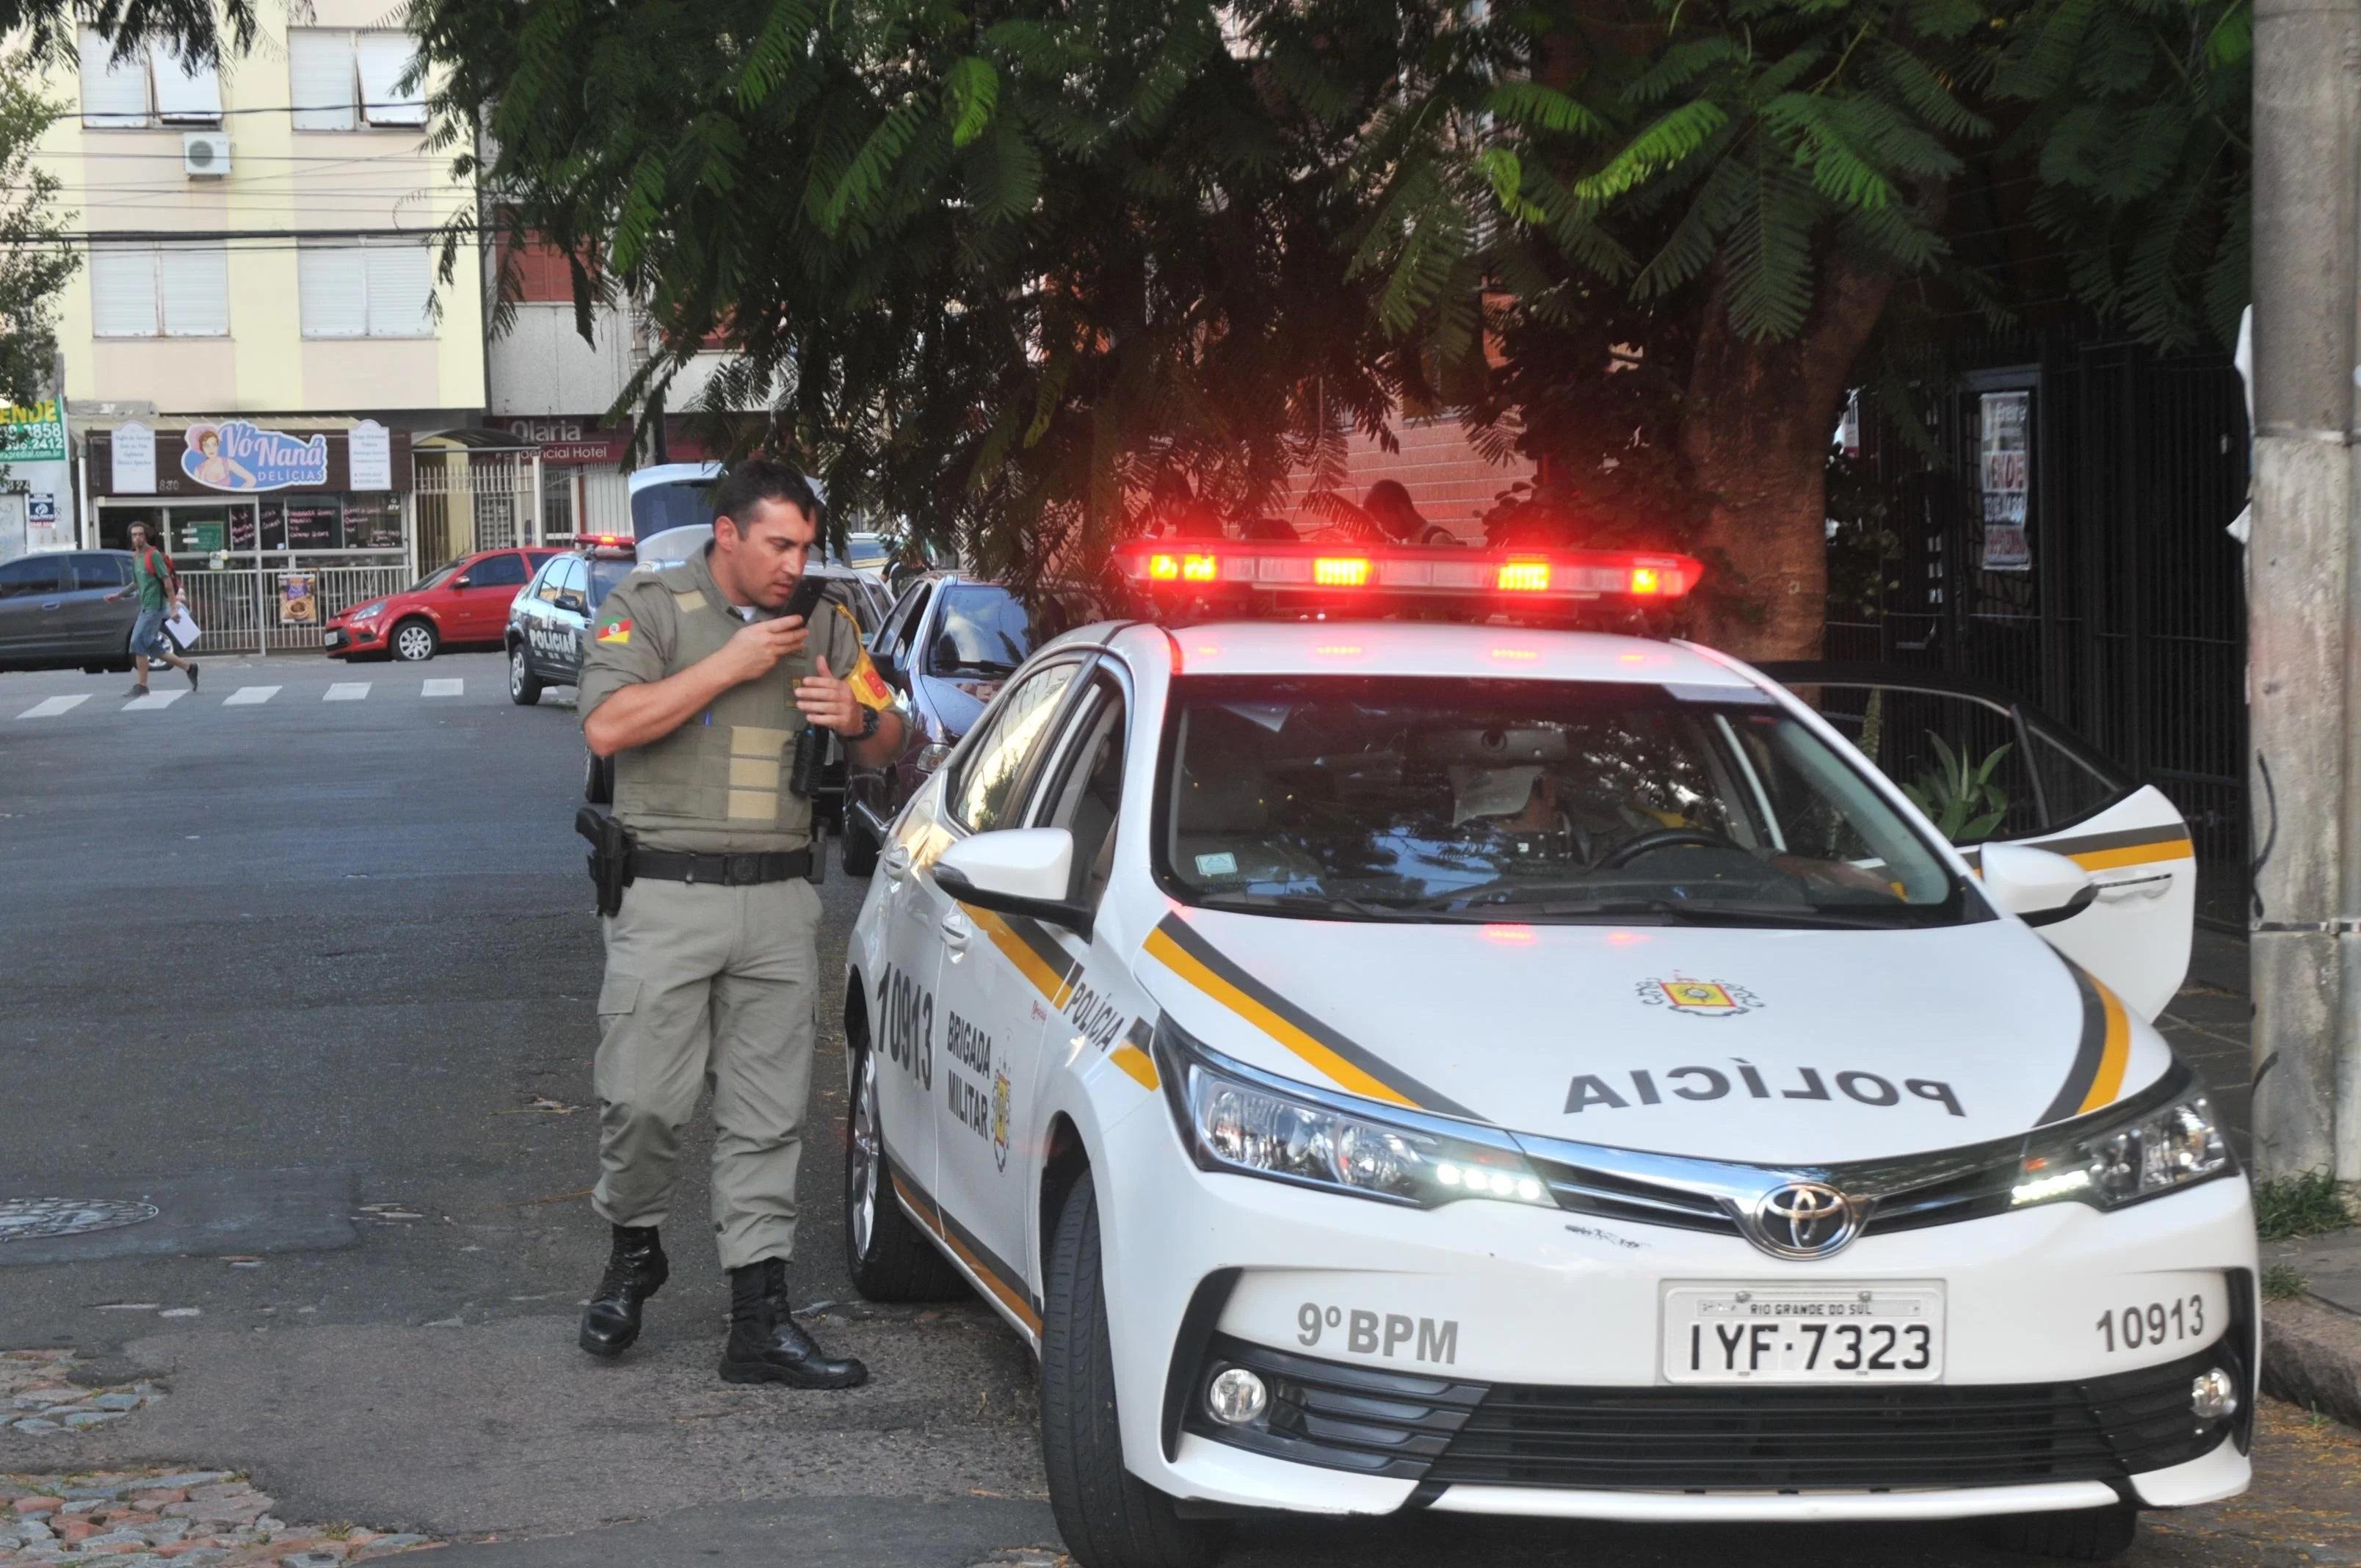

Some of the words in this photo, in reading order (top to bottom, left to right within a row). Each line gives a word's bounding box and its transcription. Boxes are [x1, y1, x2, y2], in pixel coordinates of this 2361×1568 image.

[220, 424, 253, 457] Vó
[254, 437, 322, 467] Naná
[573, 446, 606, 458] Hotel
[877, 961, 933, 1092] 10913
[947, 1010, 991, 1080] BRIGADA
[1063, 981, 1125, 1052] POLÍCIA
[948, 1069, 988, 1141] MILITAR
[1750, 1303, 1771, 1315] RIO
[1775, 1303, 1824, 1315] GRANDE
[1828, 1303, 1845, 1315] DO
[1849, 1303, 1873, 1315] SUL
[2096, 1294, 2204, 1352] 10913
